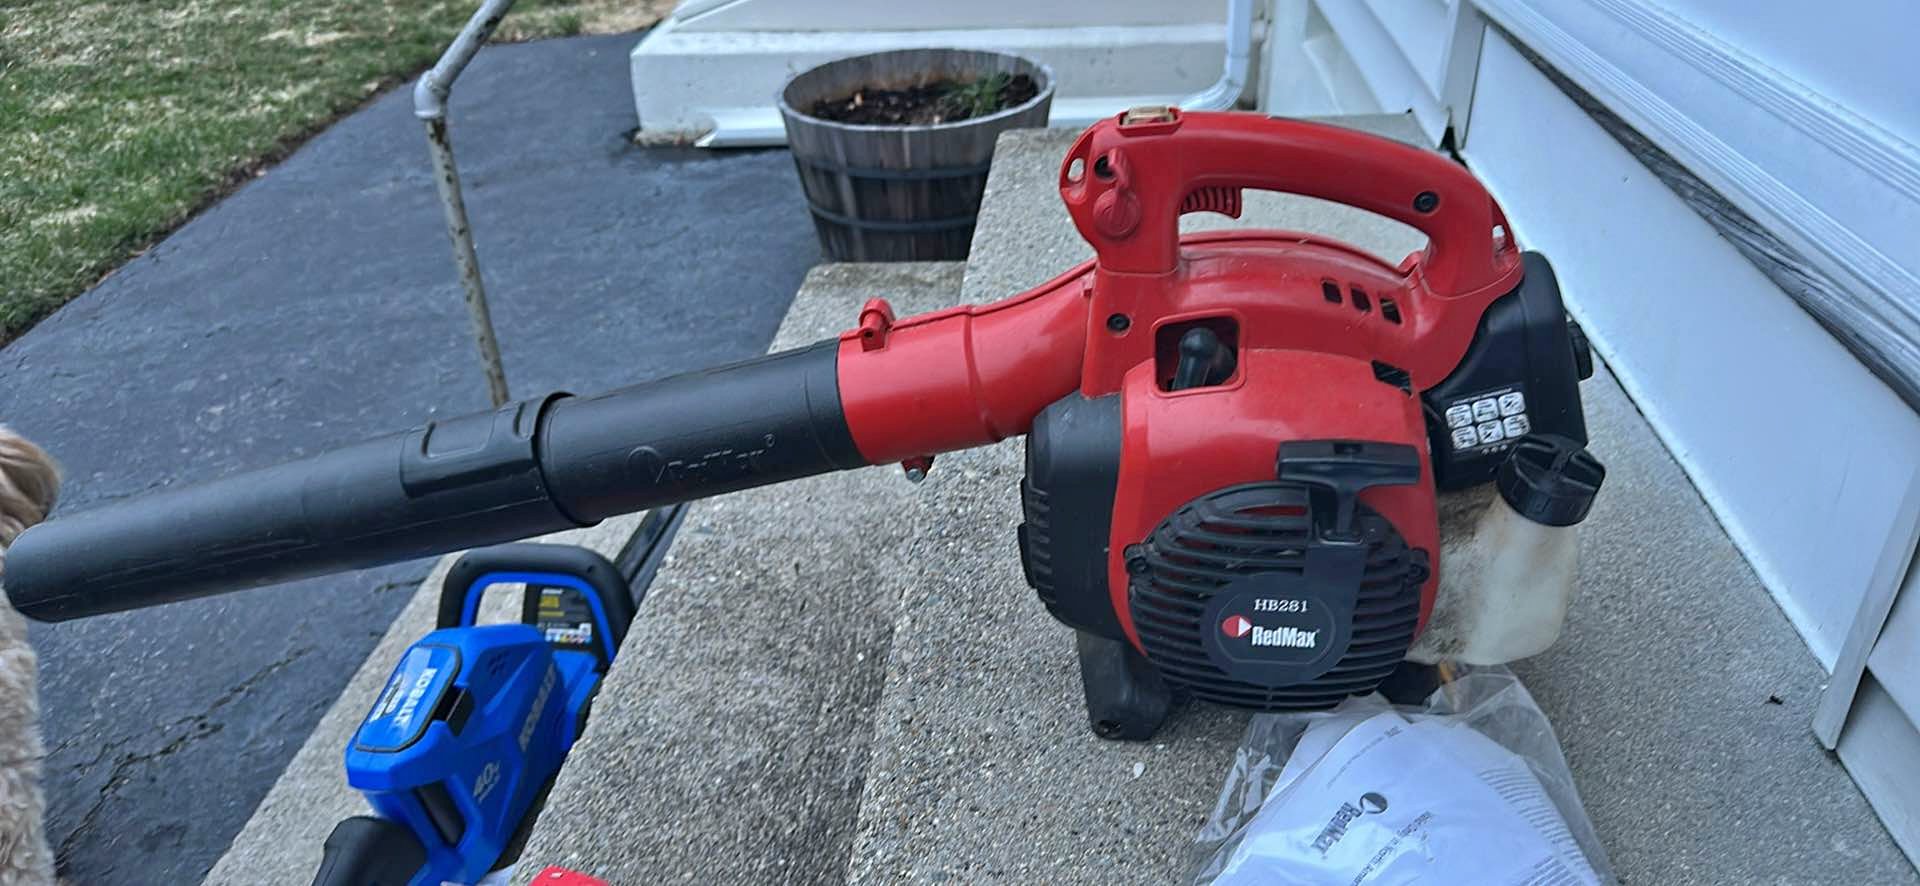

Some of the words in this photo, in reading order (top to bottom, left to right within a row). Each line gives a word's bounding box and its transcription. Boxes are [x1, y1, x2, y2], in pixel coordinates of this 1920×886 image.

[1254, 598, 1308, 613] HB281
[1251, 626, 1316, 649] RedMax
[394, 668, 438, 729] KOBALT
